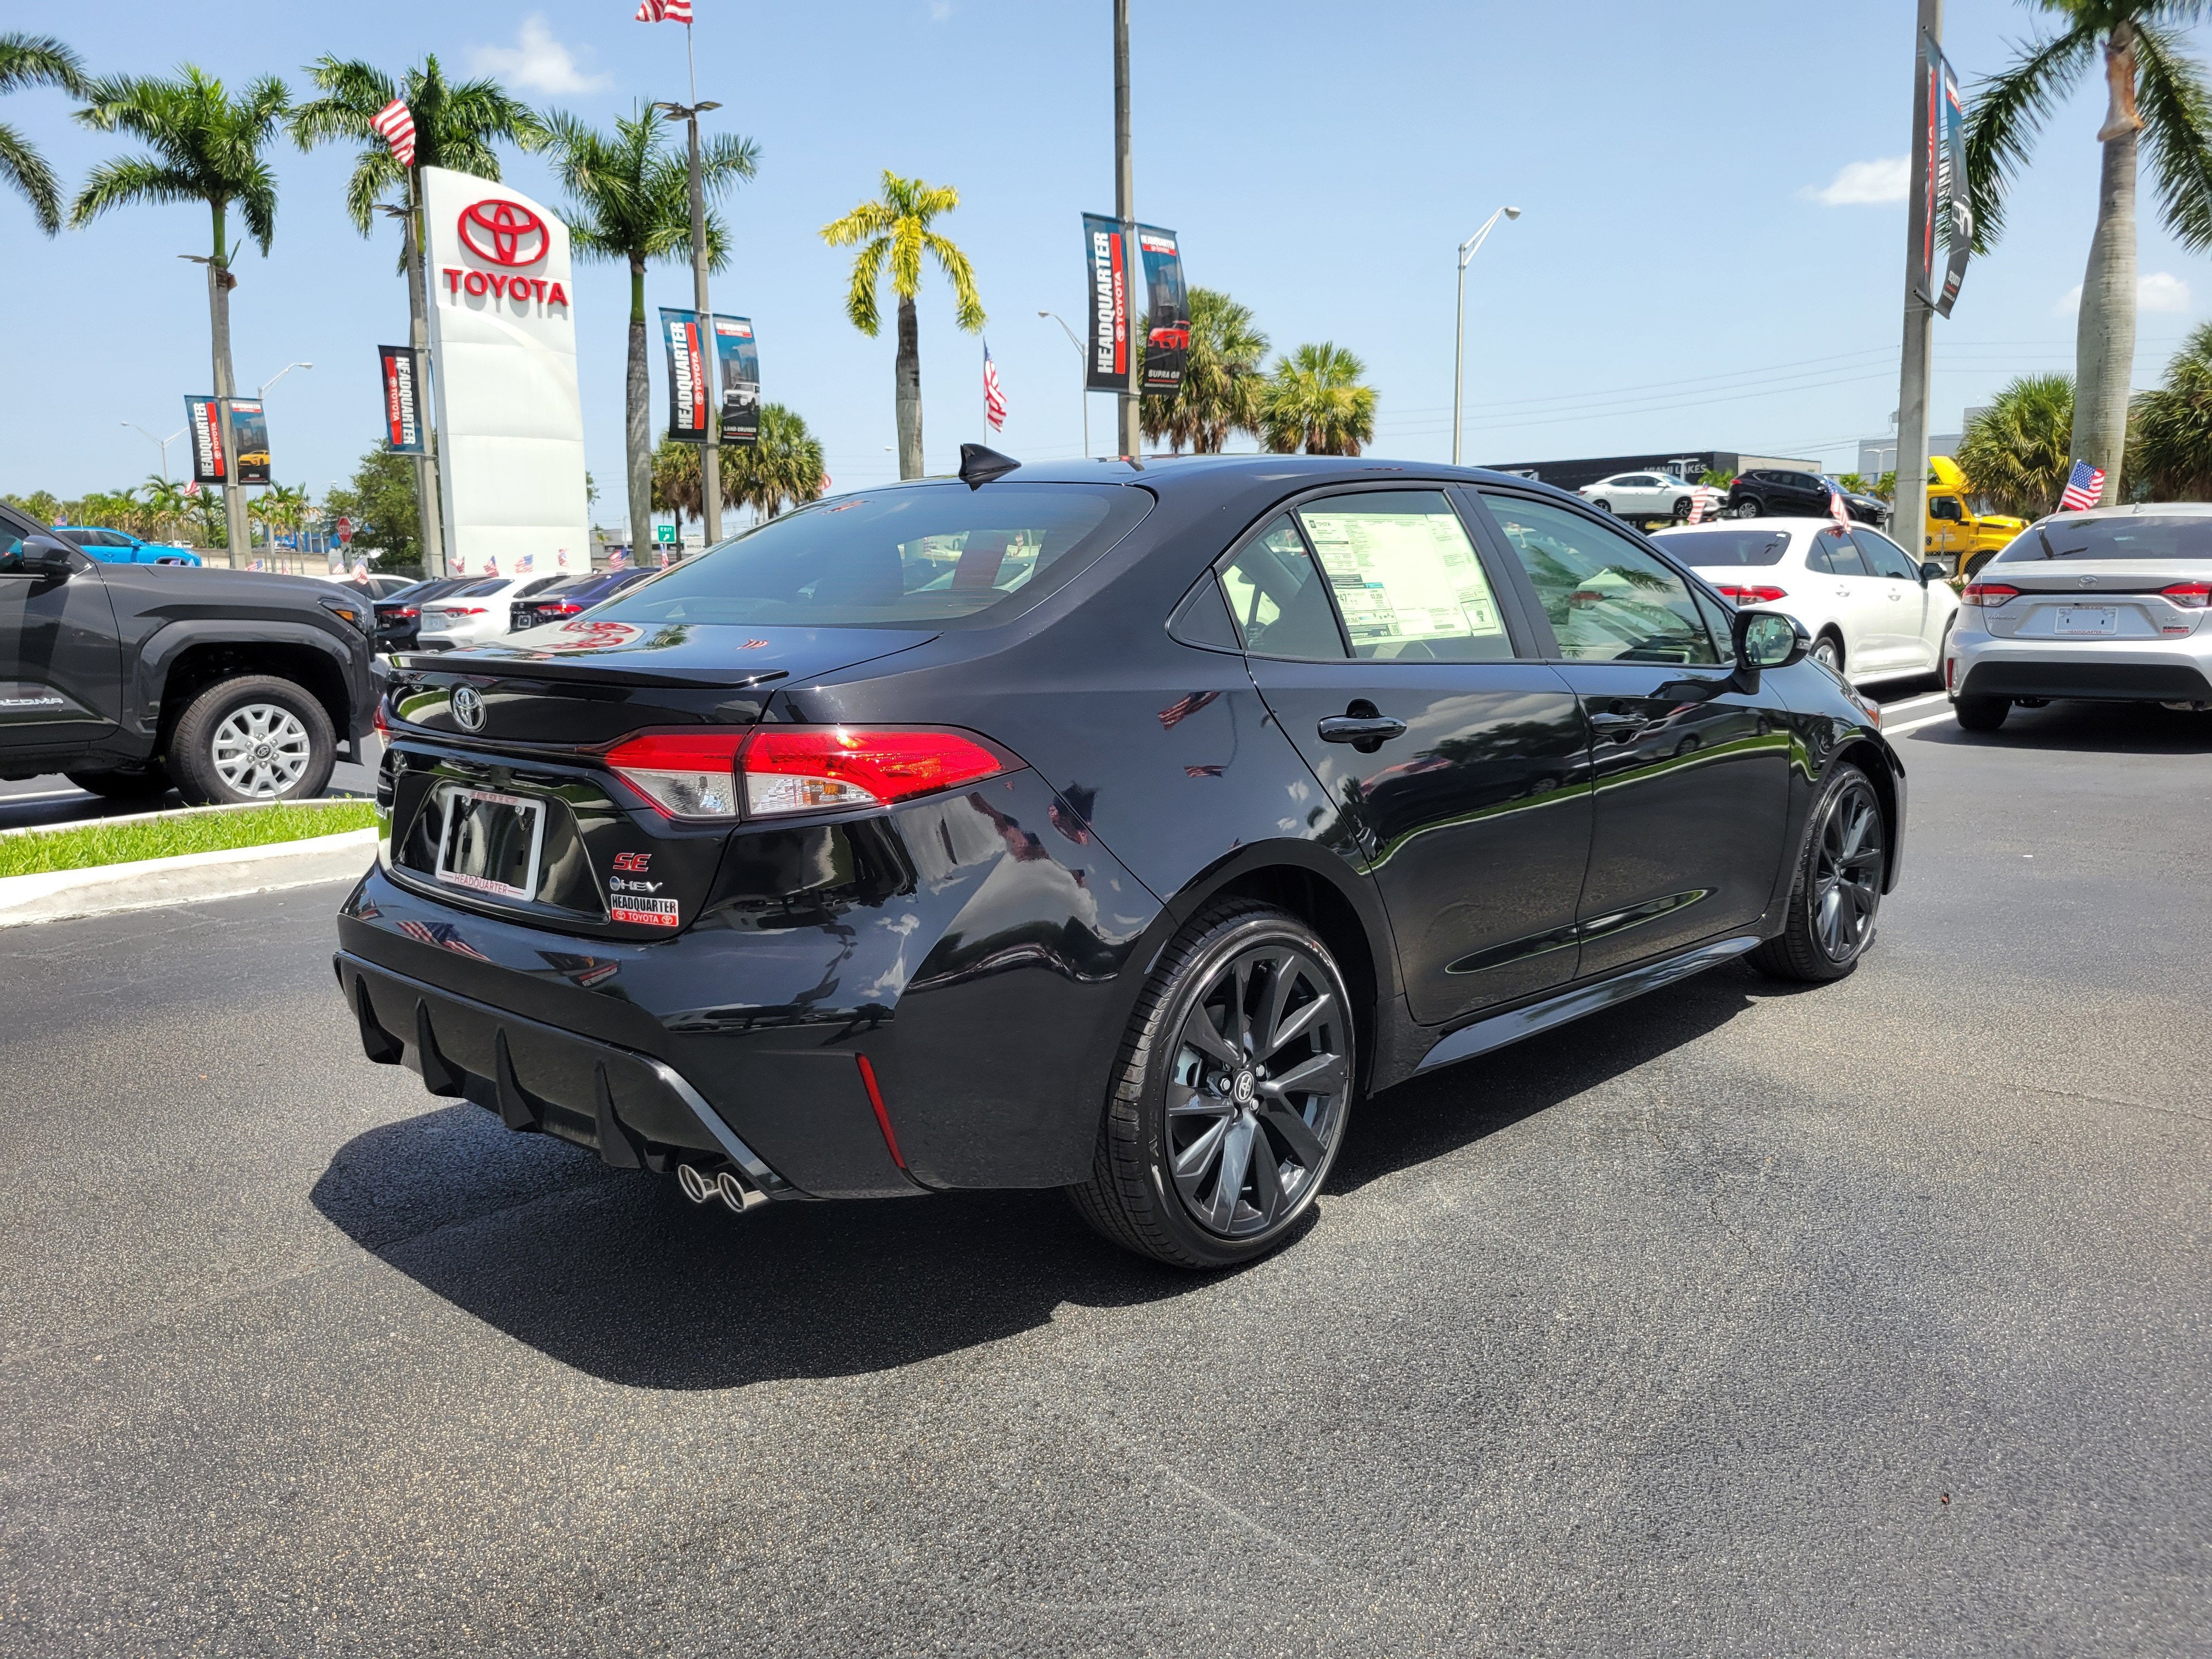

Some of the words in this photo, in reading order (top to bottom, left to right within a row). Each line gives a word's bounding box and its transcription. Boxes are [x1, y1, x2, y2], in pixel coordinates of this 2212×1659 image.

[443, 268, 568, 306] TOYOTA
[1093, 231, 1115, 374] HEADQUARTER
[1114, 271, 1124, 325] TOYOTA
[670, 321, 693, 430] HEADQUARTER
[691, 351, 702, 392] TOYOTA
[391, 389, 400, 421] TOYOTA
[396, 357, 416, 444] HEADQUARTER
[194, 402, 215, 476] HEADQUARTER
[211, 421, 220, 450] TOYOTA
[338, 526, 351, 534] STOP
[613, 852, 652, 872] SE
[454, 873, 507, 894] HEADQUARTER
[612, 895, 676, 913] HEADQUARTER
[628, 912, 659, 923] TOYOTA
